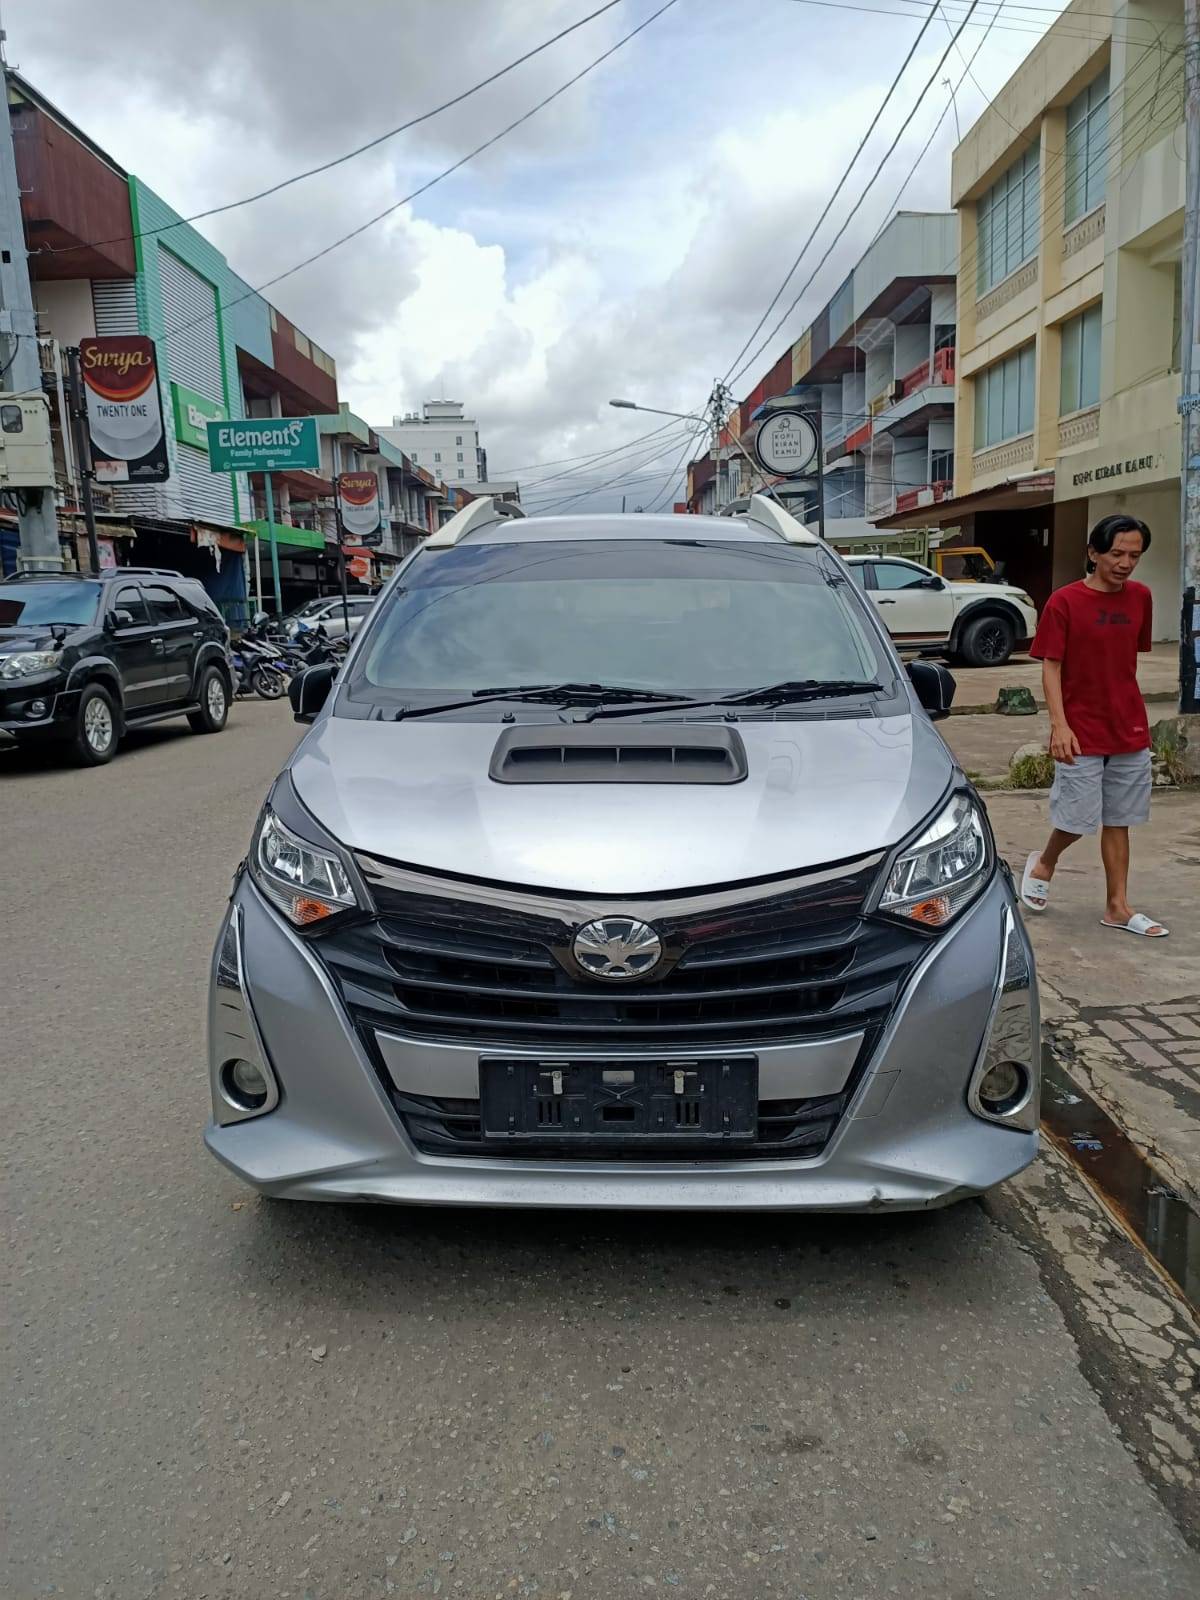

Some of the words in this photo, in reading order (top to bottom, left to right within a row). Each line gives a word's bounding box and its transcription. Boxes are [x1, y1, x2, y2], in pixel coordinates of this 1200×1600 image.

[84, 346, 151, 375] Surya
[97, 405, 129, 417] TWENTY
[131, 405, 148, 417] ONE
[230, 448, 252, 457] Family
[340, 476, 376, 491] Surya
